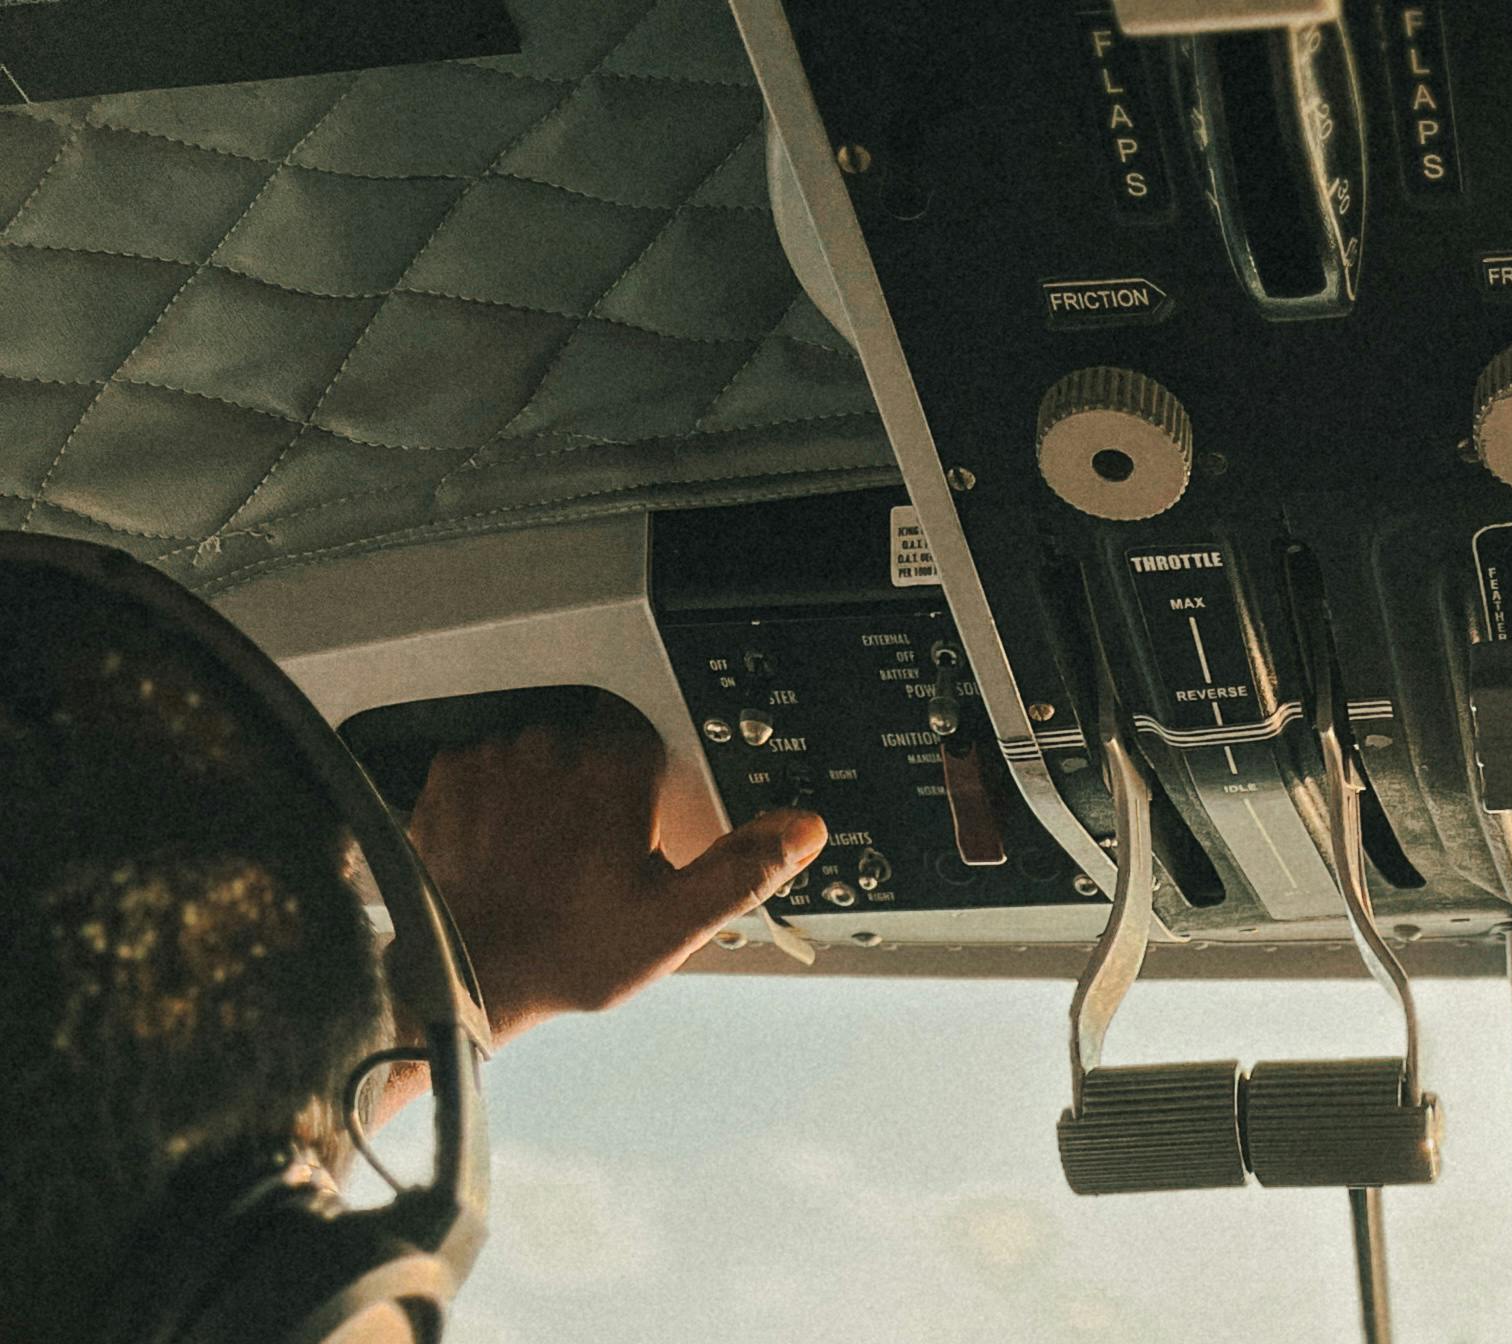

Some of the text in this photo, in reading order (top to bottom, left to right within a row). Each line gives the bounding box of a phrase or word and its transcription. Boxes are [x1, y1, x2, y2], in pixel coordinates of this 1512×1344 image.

[1405, 10, 1445, 180] FLAPS
[1093, 30, 1148, 197] FLAPS
[1050, 288, 1150, 311] FRICTION
[1130, 552, 1224, 573] THROTTLE
[1169, 597, 1207, 611] MAX
[861, 632, 912, 647] EXTERNAL
[896, 650, 915, 663] OFF
[879, 667, 919, 681] BATTERY
[905, 683, 937, 699] POW
[1175, 685, 1249, 702] REVERSE
[768, 737, 807, 752] START
[907, 752, 943, 764] MANUA
[749, 772, 770, 784] LEFT
[828, 768, 857, 781] RIGHT
[1223, 782, 1259, 794] IDLE
[828, 830, 873, 846] LIGHTS
